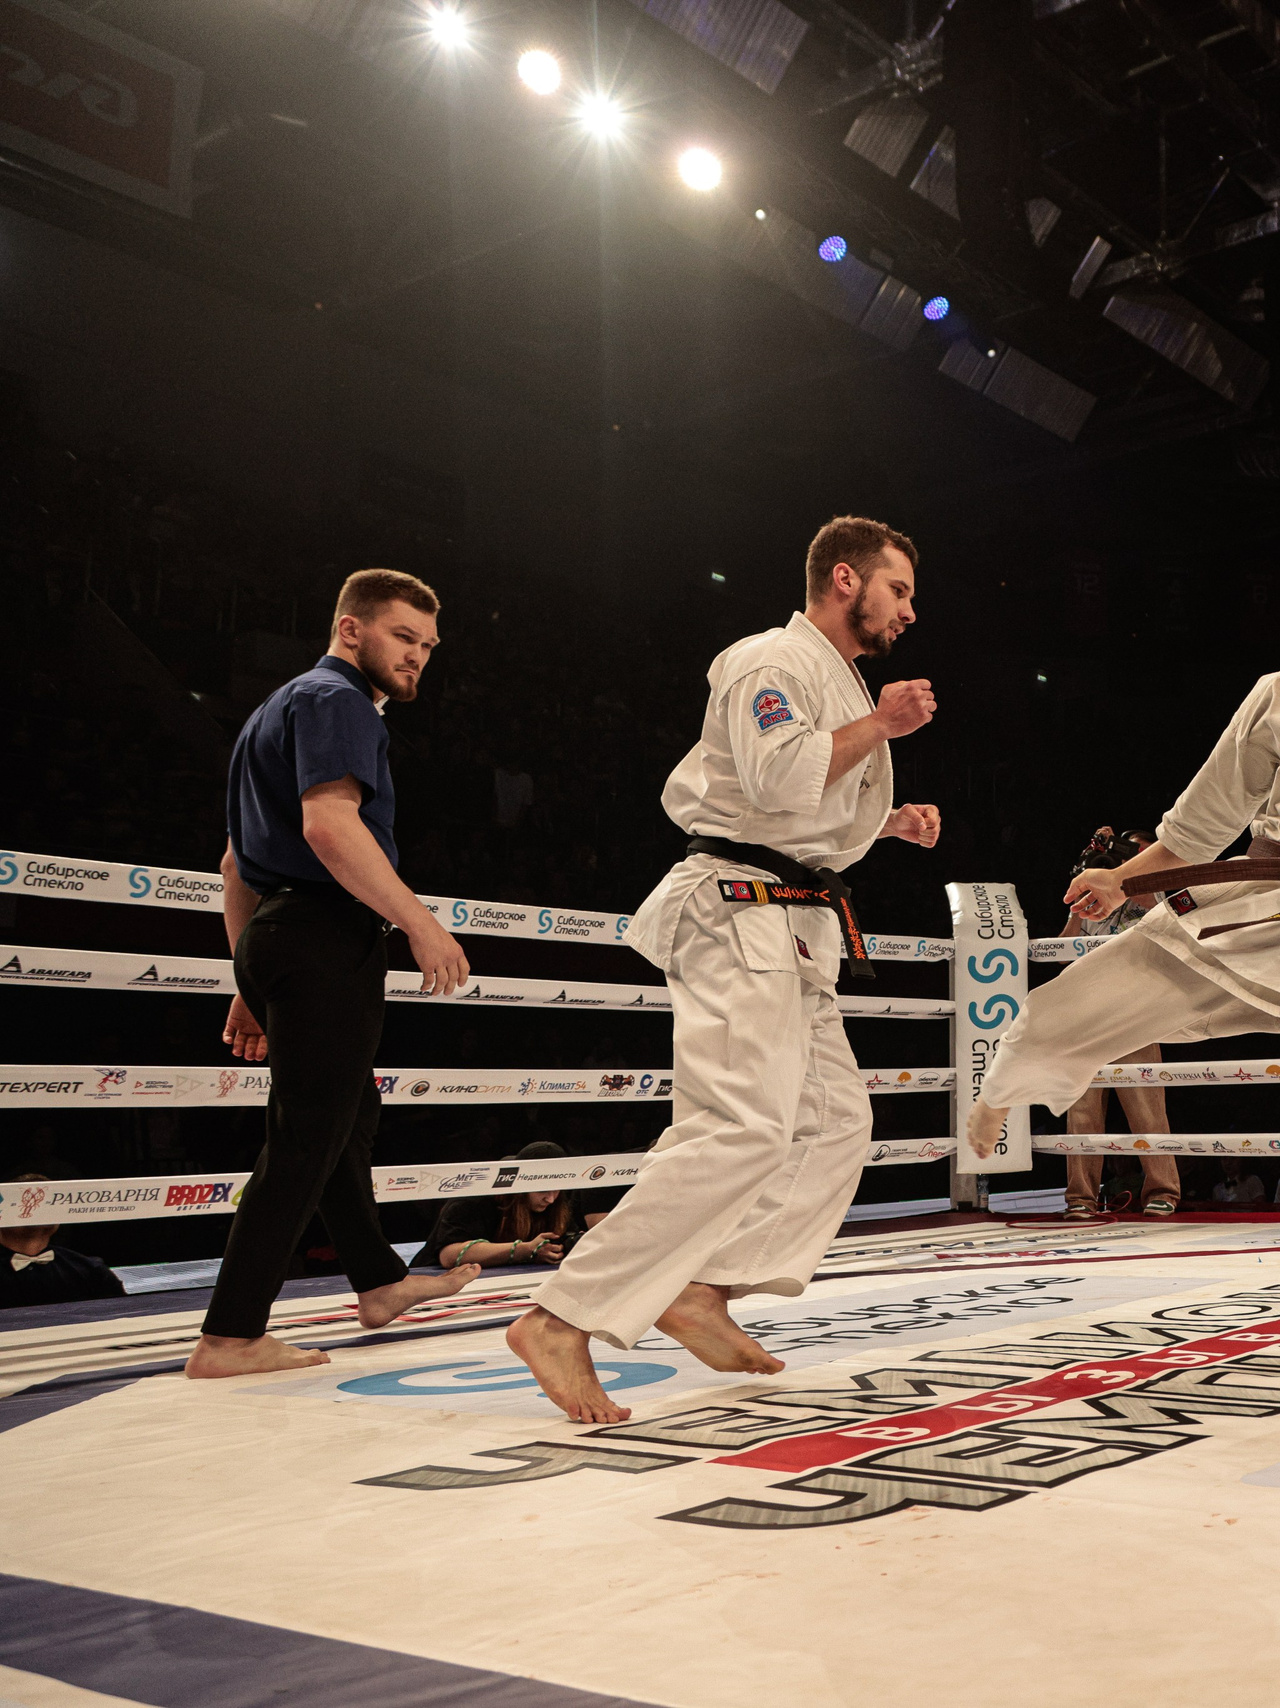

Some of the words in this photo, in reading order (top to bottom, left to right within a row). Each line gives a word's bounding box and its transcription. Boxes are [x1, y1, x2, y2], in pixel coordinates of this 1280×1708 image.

[27, 861, 110, 881] Сибирское
[23, 875, 84, 891] Стекло
[158, 875, 224, 893] Сибирско
[155, 888, 210, 903] Стекло
[473, 907, 526, 922] Сибирское
[972, 885, 995, 939] Сибирское
[995, 894, 1015, 939] Стекло
[470, 918, 509, 930] Стекло
[557, 915, 605, 928] Сибирское
[554, 925, 589, 937] Стекло
[26, 968, 92, 979] АВАНГАРД
[162, 976, 221, 985] АВАНГАРД
[439, 1085, 512, 1093] КИНОСИТИ
[539, 1080, 587, 1091] Климат54
[497, 1174, 516, 1183] ГИС
[517, 1171, 577, 1182] Недвижимость
[50, 1188, 161, 1206] РАКОВАРНЯ
[164, 1183, 234, 1207] BROZEX
[107, 1205, 136, 1213] ТОЛЬКО
